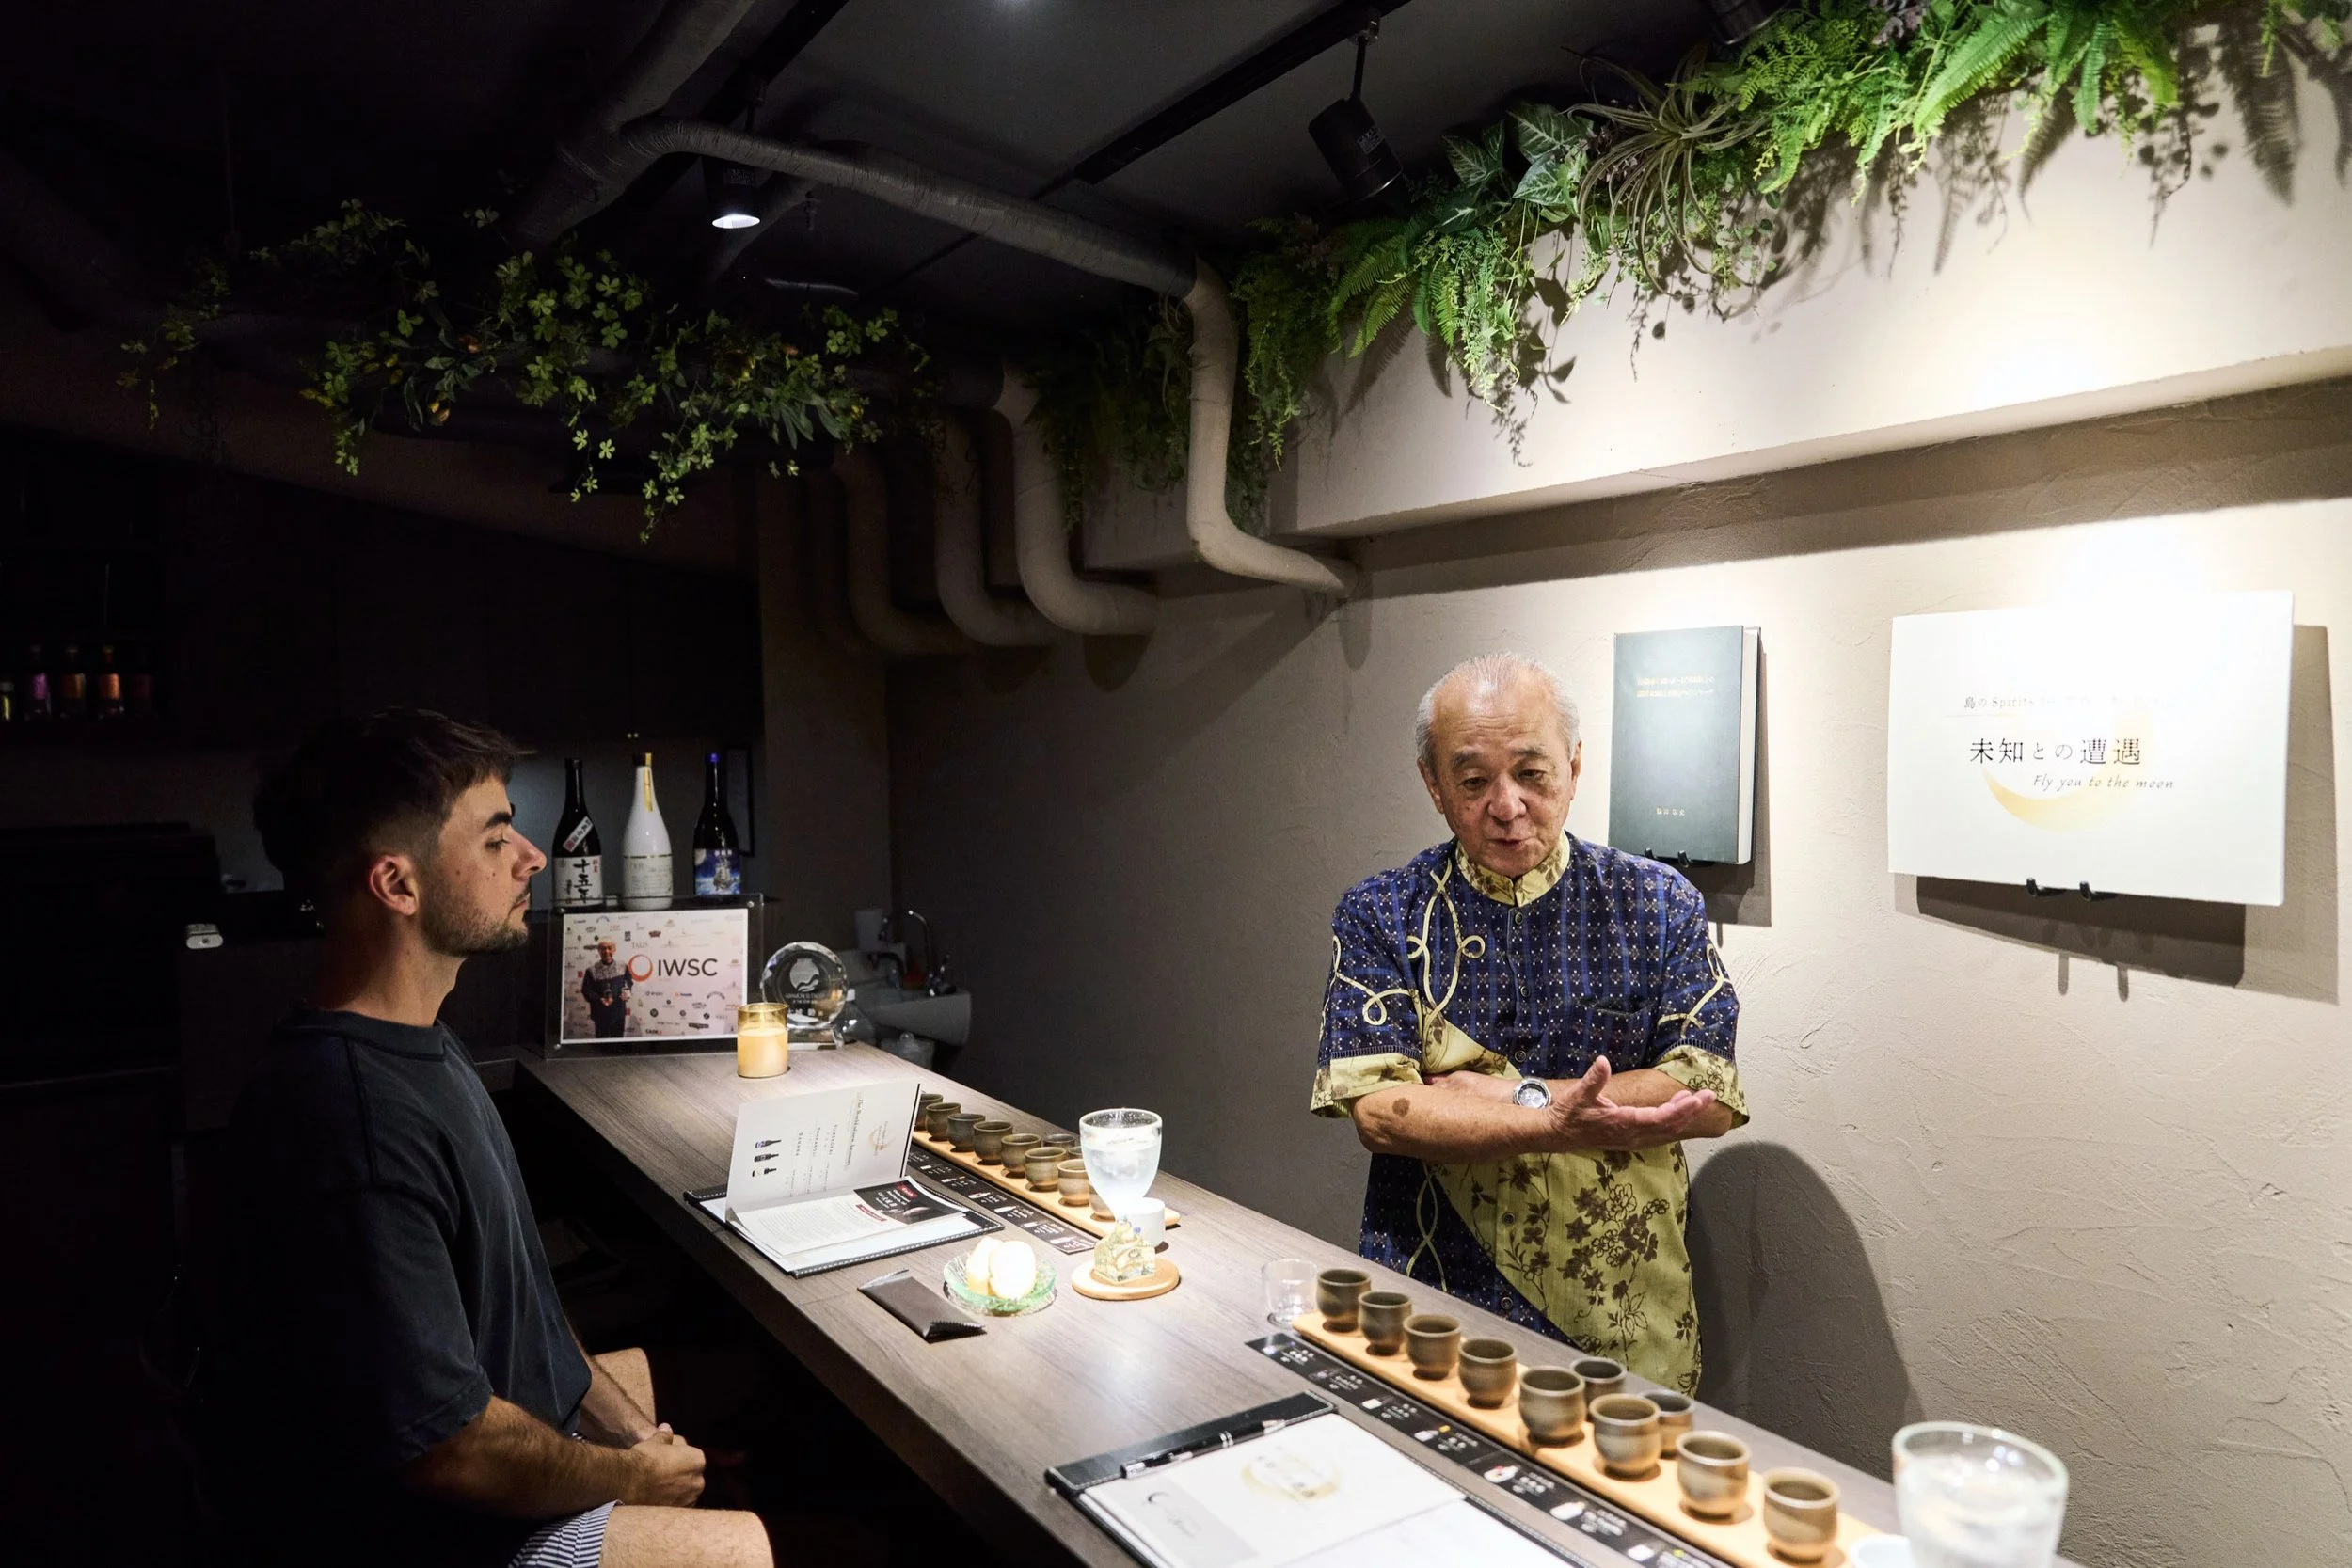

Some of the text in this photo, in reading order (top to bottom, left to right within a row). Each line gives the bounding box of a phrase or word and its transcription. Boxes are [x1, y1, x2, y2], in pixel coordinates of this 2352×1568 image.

[1991, 696, 2034, 709] Spirits
[1970, 737, 2140, 765] 未知との遭遇
[2032, 774, 2174, 792] Fly you to the moon
[658, 958, 718, 977] IWSC
